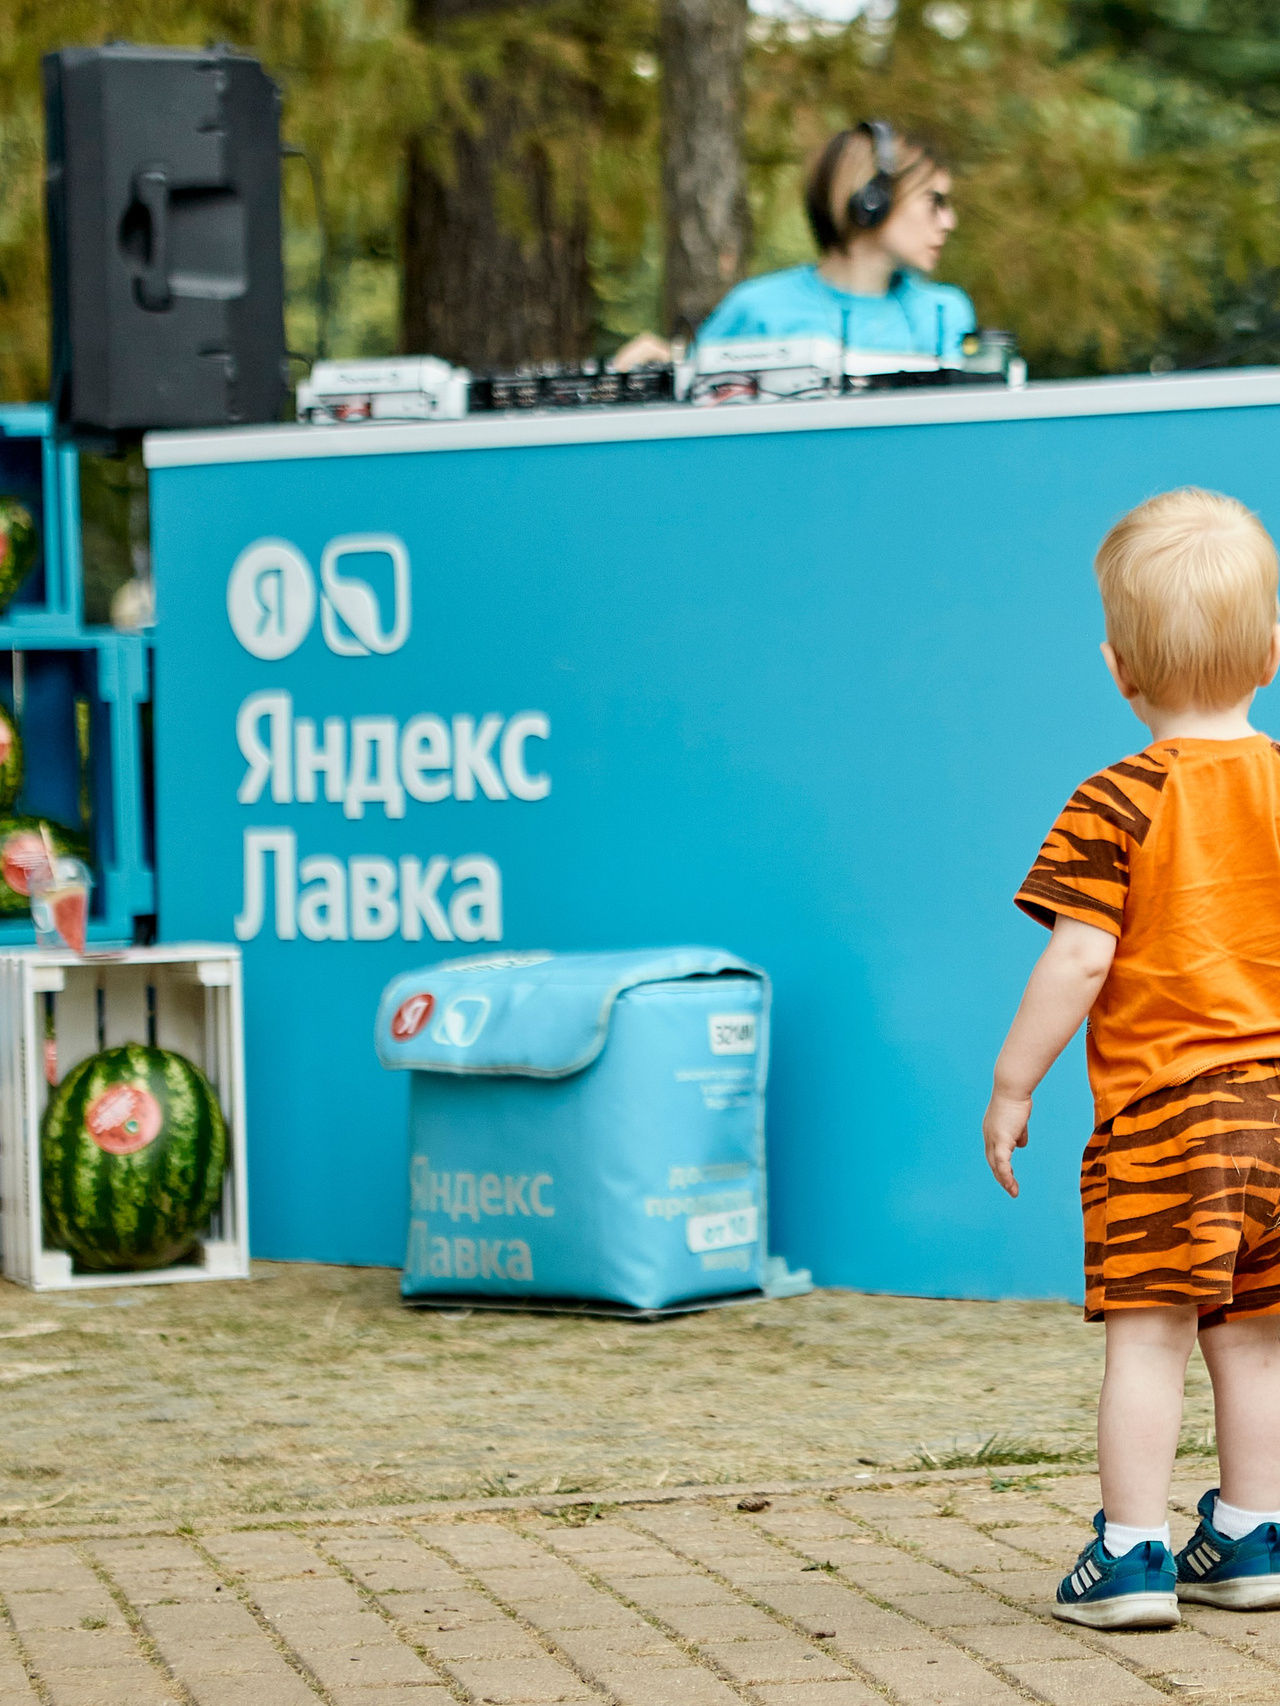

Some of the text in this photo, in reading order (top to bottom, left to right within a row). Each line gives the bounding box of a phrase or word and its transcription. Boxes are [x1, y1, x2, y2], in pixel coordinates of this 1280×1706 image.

[236, 690, 551, 819] Яндекс
[234, 826, 504, 942] Лавка
[411, 1155, 556, 1223] Яндекс
